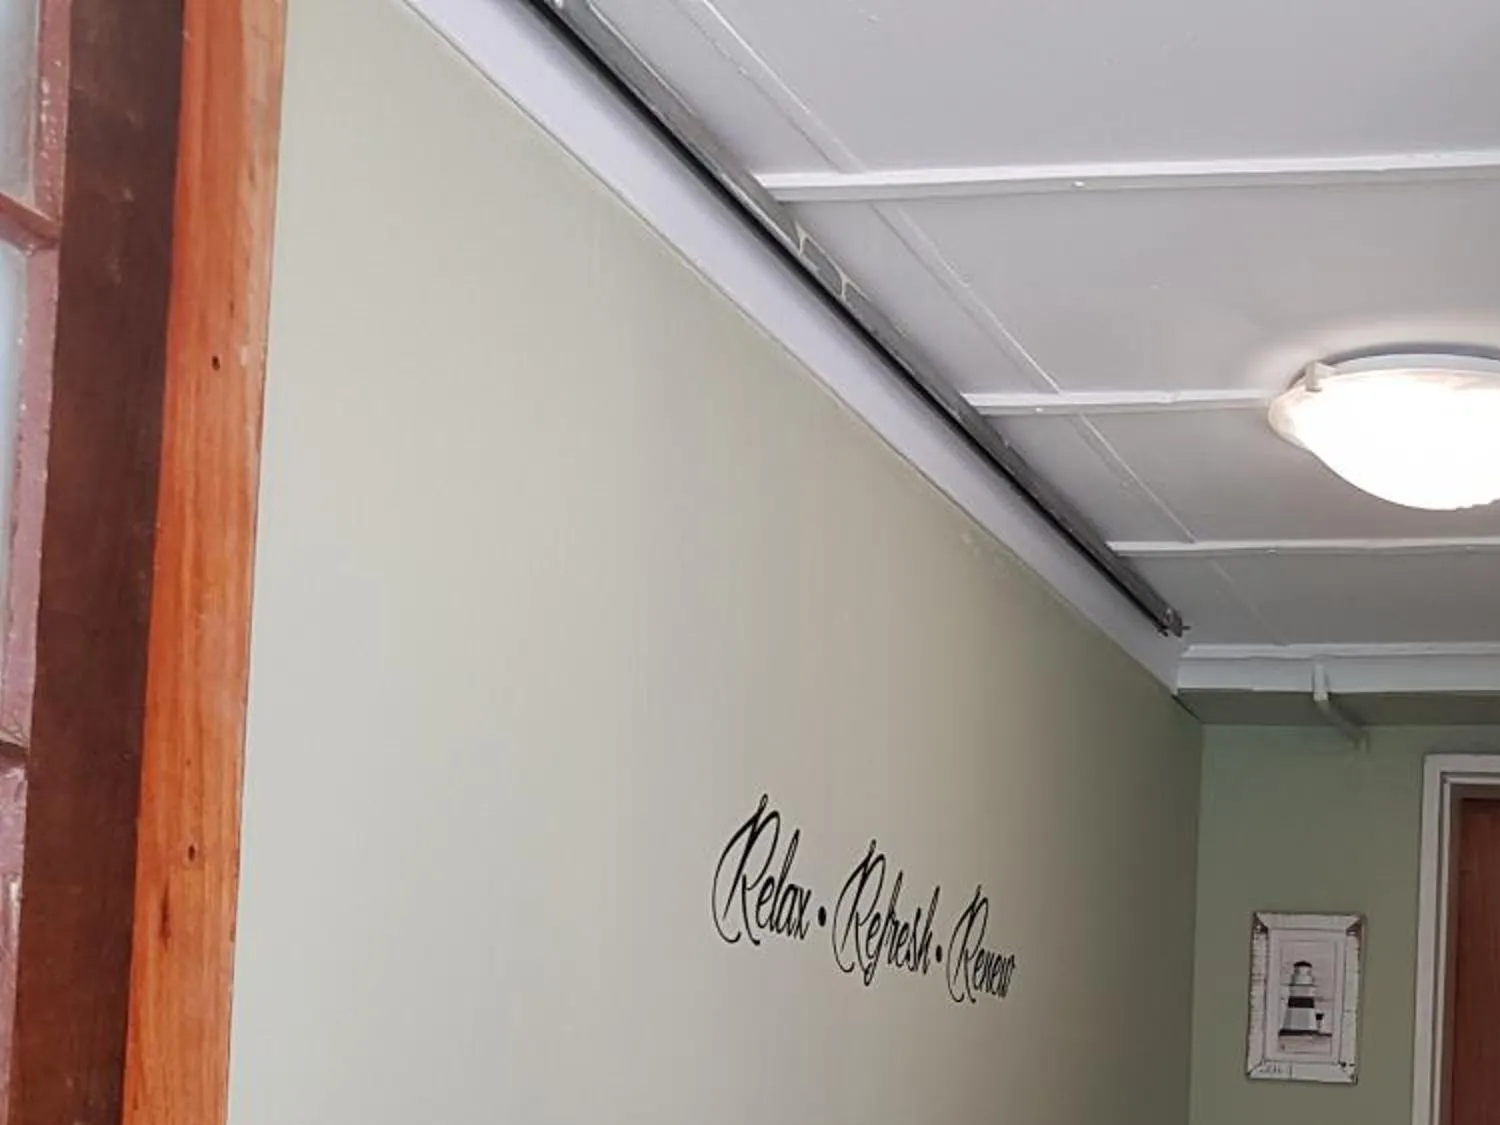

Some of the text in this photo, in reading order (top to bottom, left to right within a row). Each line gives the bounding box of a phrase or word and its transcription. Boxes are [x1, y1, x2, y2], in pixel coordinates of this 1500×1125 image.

[712, 793, 1016, 1003] Relax Refresh Renew
